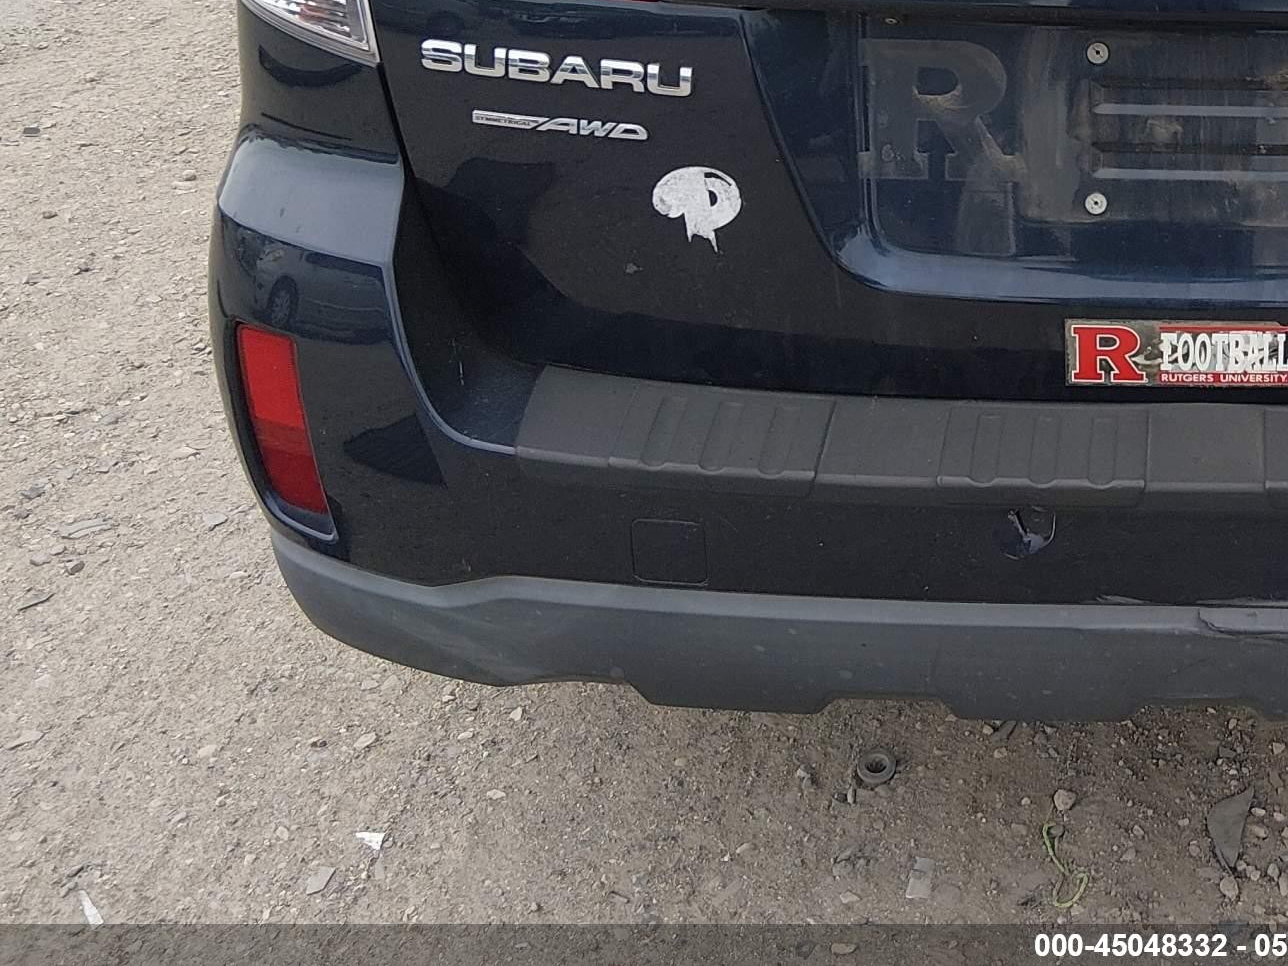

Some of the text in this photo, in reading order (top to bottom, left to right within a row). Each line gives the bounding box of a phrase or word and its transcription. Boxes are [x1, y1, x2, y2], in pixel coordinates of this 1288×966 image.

[421, 39, 692, 97] SUBARU
[536, 118, 648, 140] AWD
[1071, 325, 1148, 383] R
[1161, 373, 1288, 383] RUTGERS UNIVERSITY
